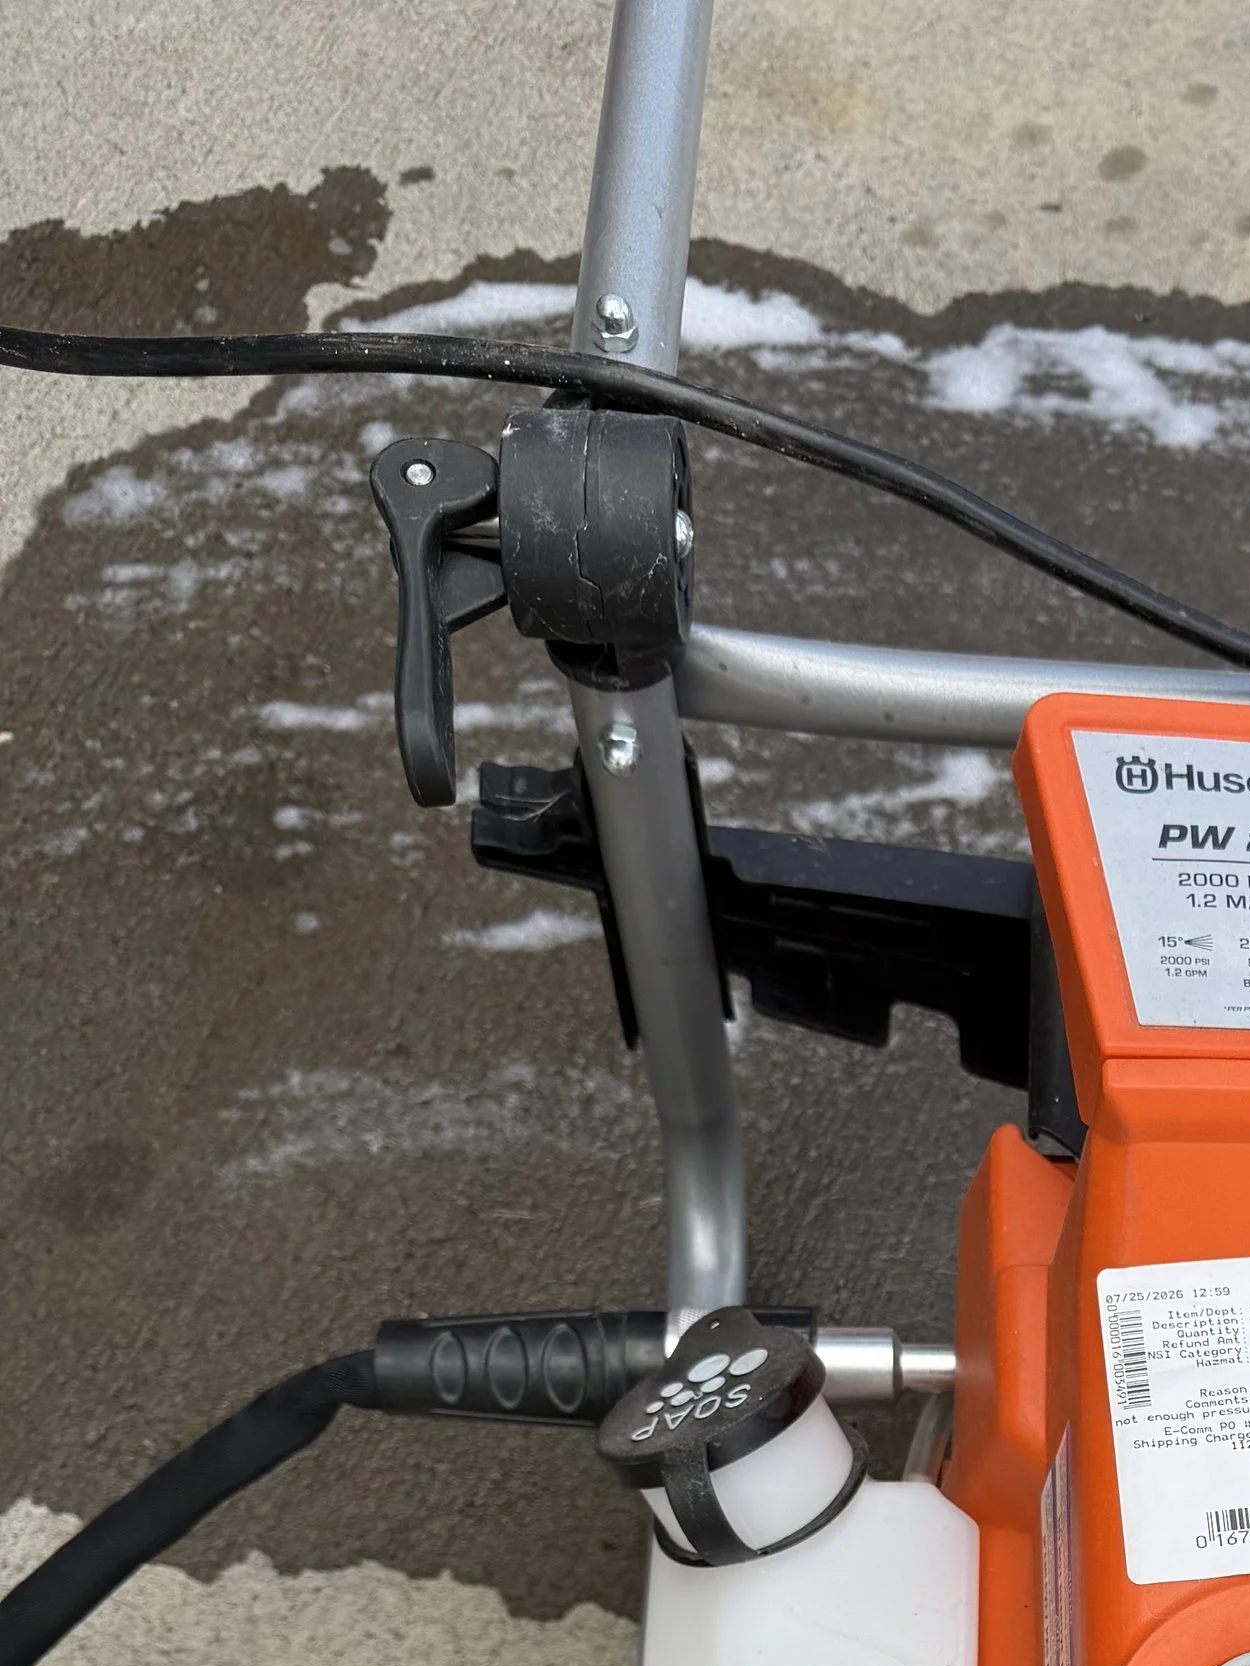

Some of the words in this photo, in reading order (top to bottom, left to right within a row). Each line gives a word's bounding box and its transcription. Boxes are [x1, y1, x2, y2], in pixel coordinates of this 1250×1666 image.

[1158, 824, 1236, 850] PW
[1178, 873, 1239, 888] 2000
[1186, 894, 1216, 908] 1.2
[1160, 956, 1191, 965] 2000
[1165, 968, 1182, 976] 1.2
[1106, 1290, 1184, 1304] 07/25/2026
[1193, 1287, 1230, 1298] 12:59
[1152, 1318, 1244, 1329] Description:
[1177, 1326, 1245, 1338] Quantity:
[1163, 1339, 1209, 1348] Refund
[1148, 1350, 1171, 1359] NSI
[1180, 1348, 1247, 1358] Category:
[630, 1383, 752, 1442] SOAP
[1115, 1415, 1138, 1427] not
[1148, 1412, 1194, 1422] enough
[1164, 1426, 1213, 1436] E-Comm
[1220, 1422, 1235, 1430] PO
[1133, 1438, 1198, 1450] Shipping
